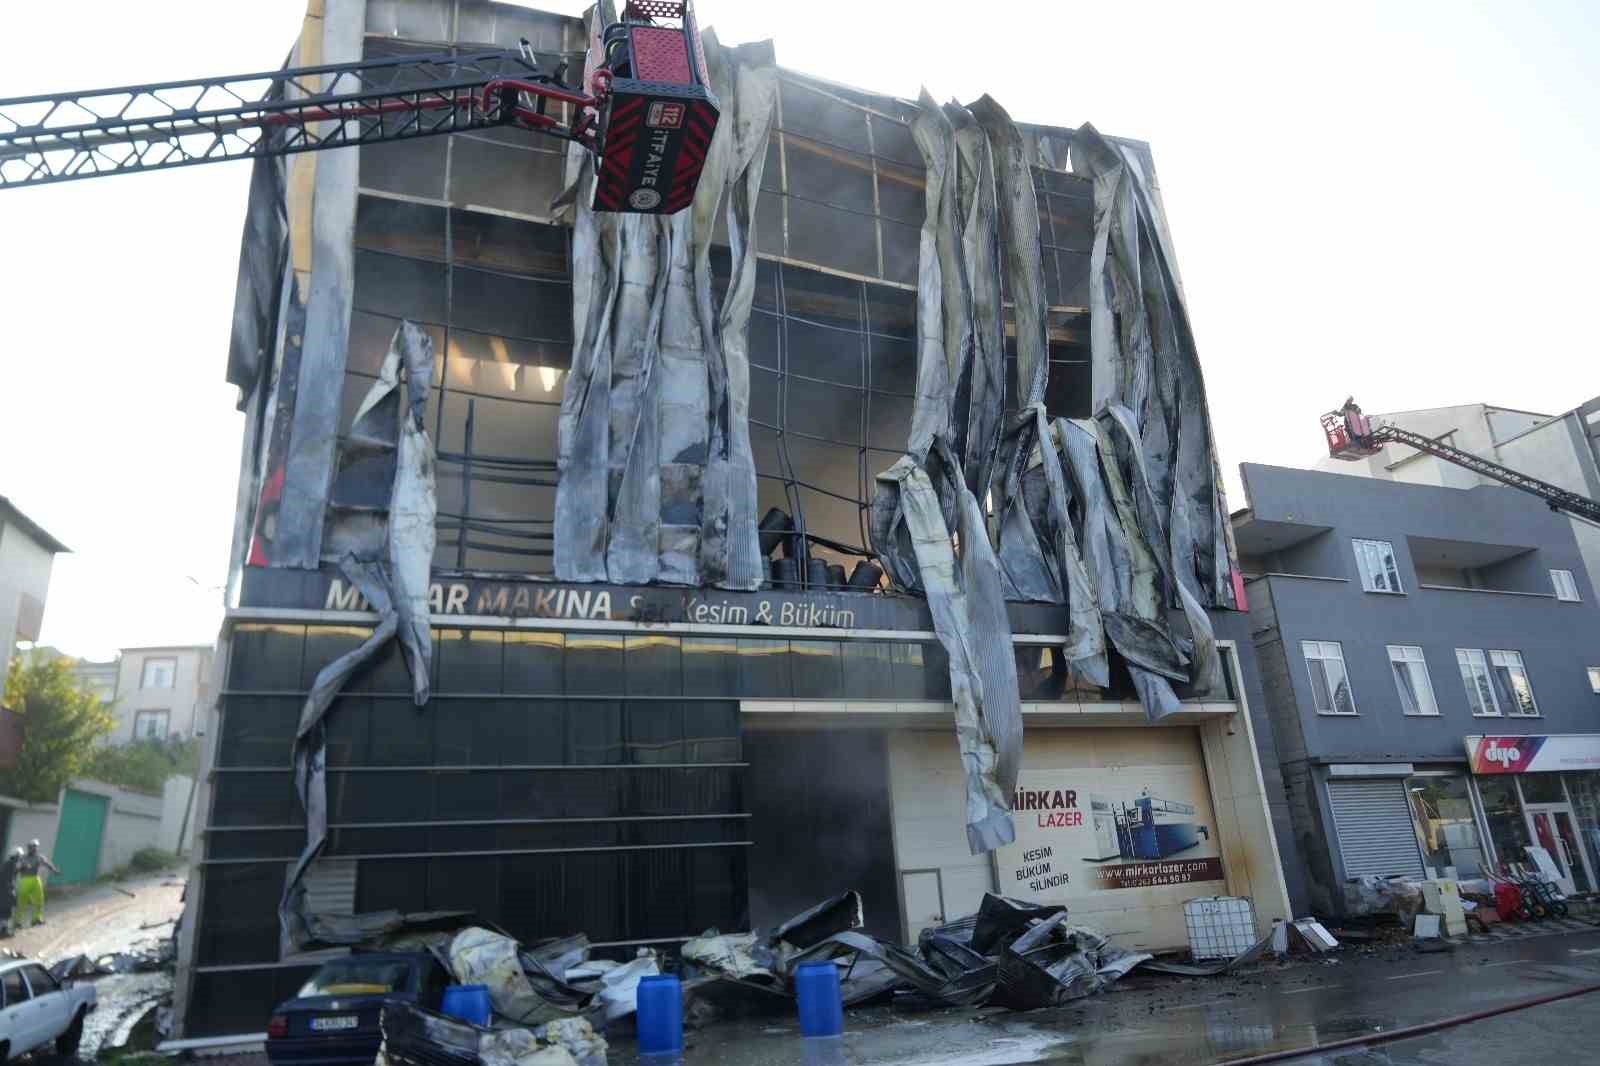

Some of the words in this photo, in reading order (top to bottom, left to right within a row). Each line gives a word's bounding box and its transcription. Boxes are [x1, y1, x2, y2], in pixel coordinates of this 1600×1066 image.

[662, 105, 680, 127] 112
[755, 600, 773, 625] &
[1038, 811, 1083, 828] LAZER
